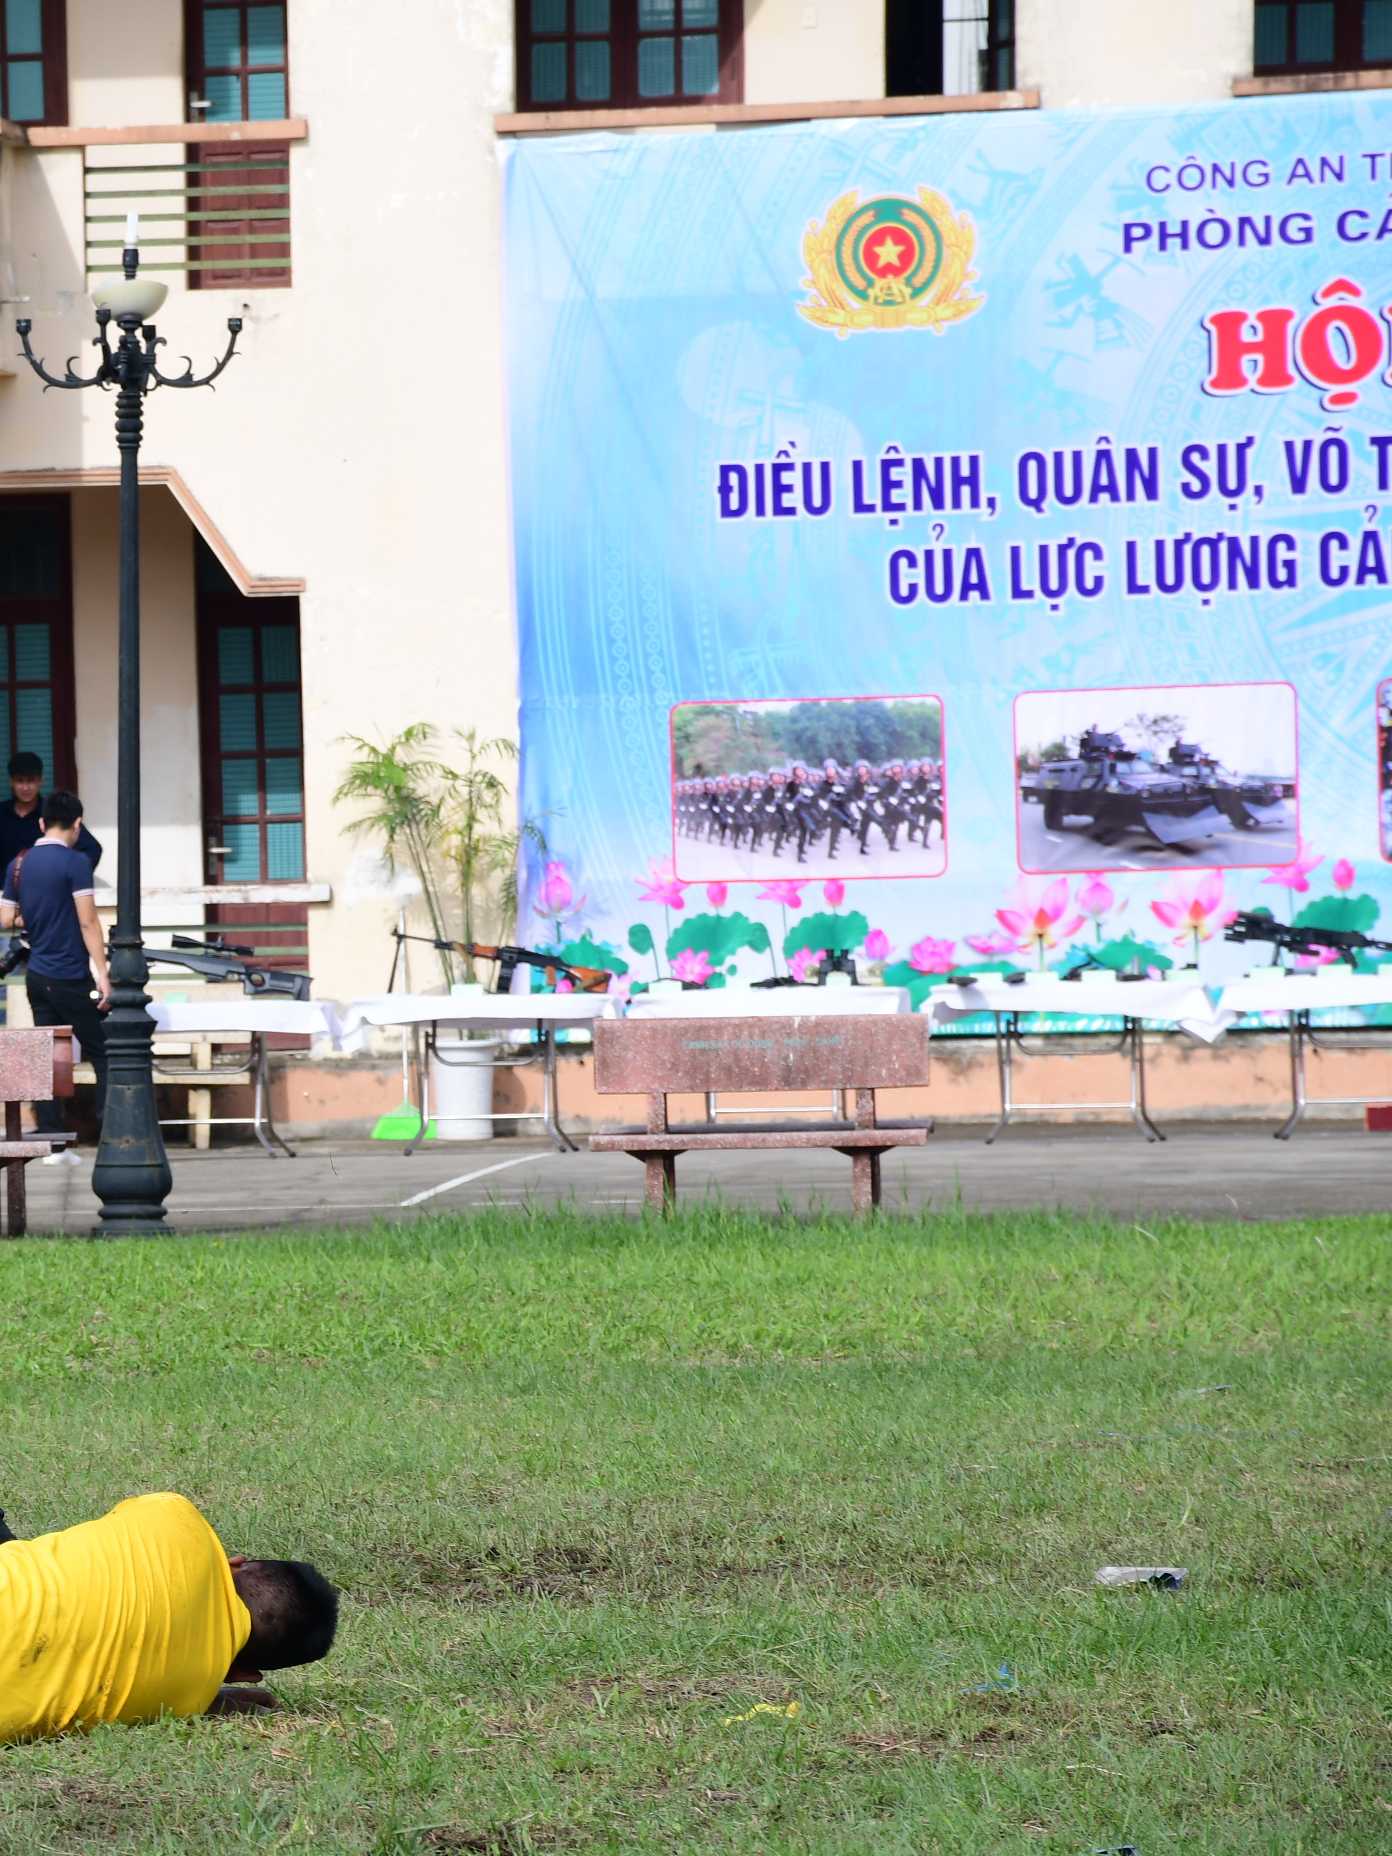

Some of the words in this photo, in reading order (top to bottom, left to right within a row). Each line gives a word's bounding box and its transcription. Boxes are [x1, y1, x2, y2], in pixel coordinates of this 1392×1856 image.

[1146, 155, 1270, 194] CÔNG
[1286, 155, 1346, 187] AN
[1123, 208, 1314, 254] PHÒNG
[1205, 277, 1392, 410] HỘ
[717, 440, 832, 519] ĐIỀU
[851, 445, 997, 527] LỆNH,
[1018, 436, 1159, 514] QUÂN
[1180, 435, 1264, 511] SỰ,
[1283, 425, 1350, 495] VÕ
[888, 522, 992, 606] CỦA
[1010, 536, 1105, 612] LỰC
[1125, 531, 1298, 607] LƯỢNG
